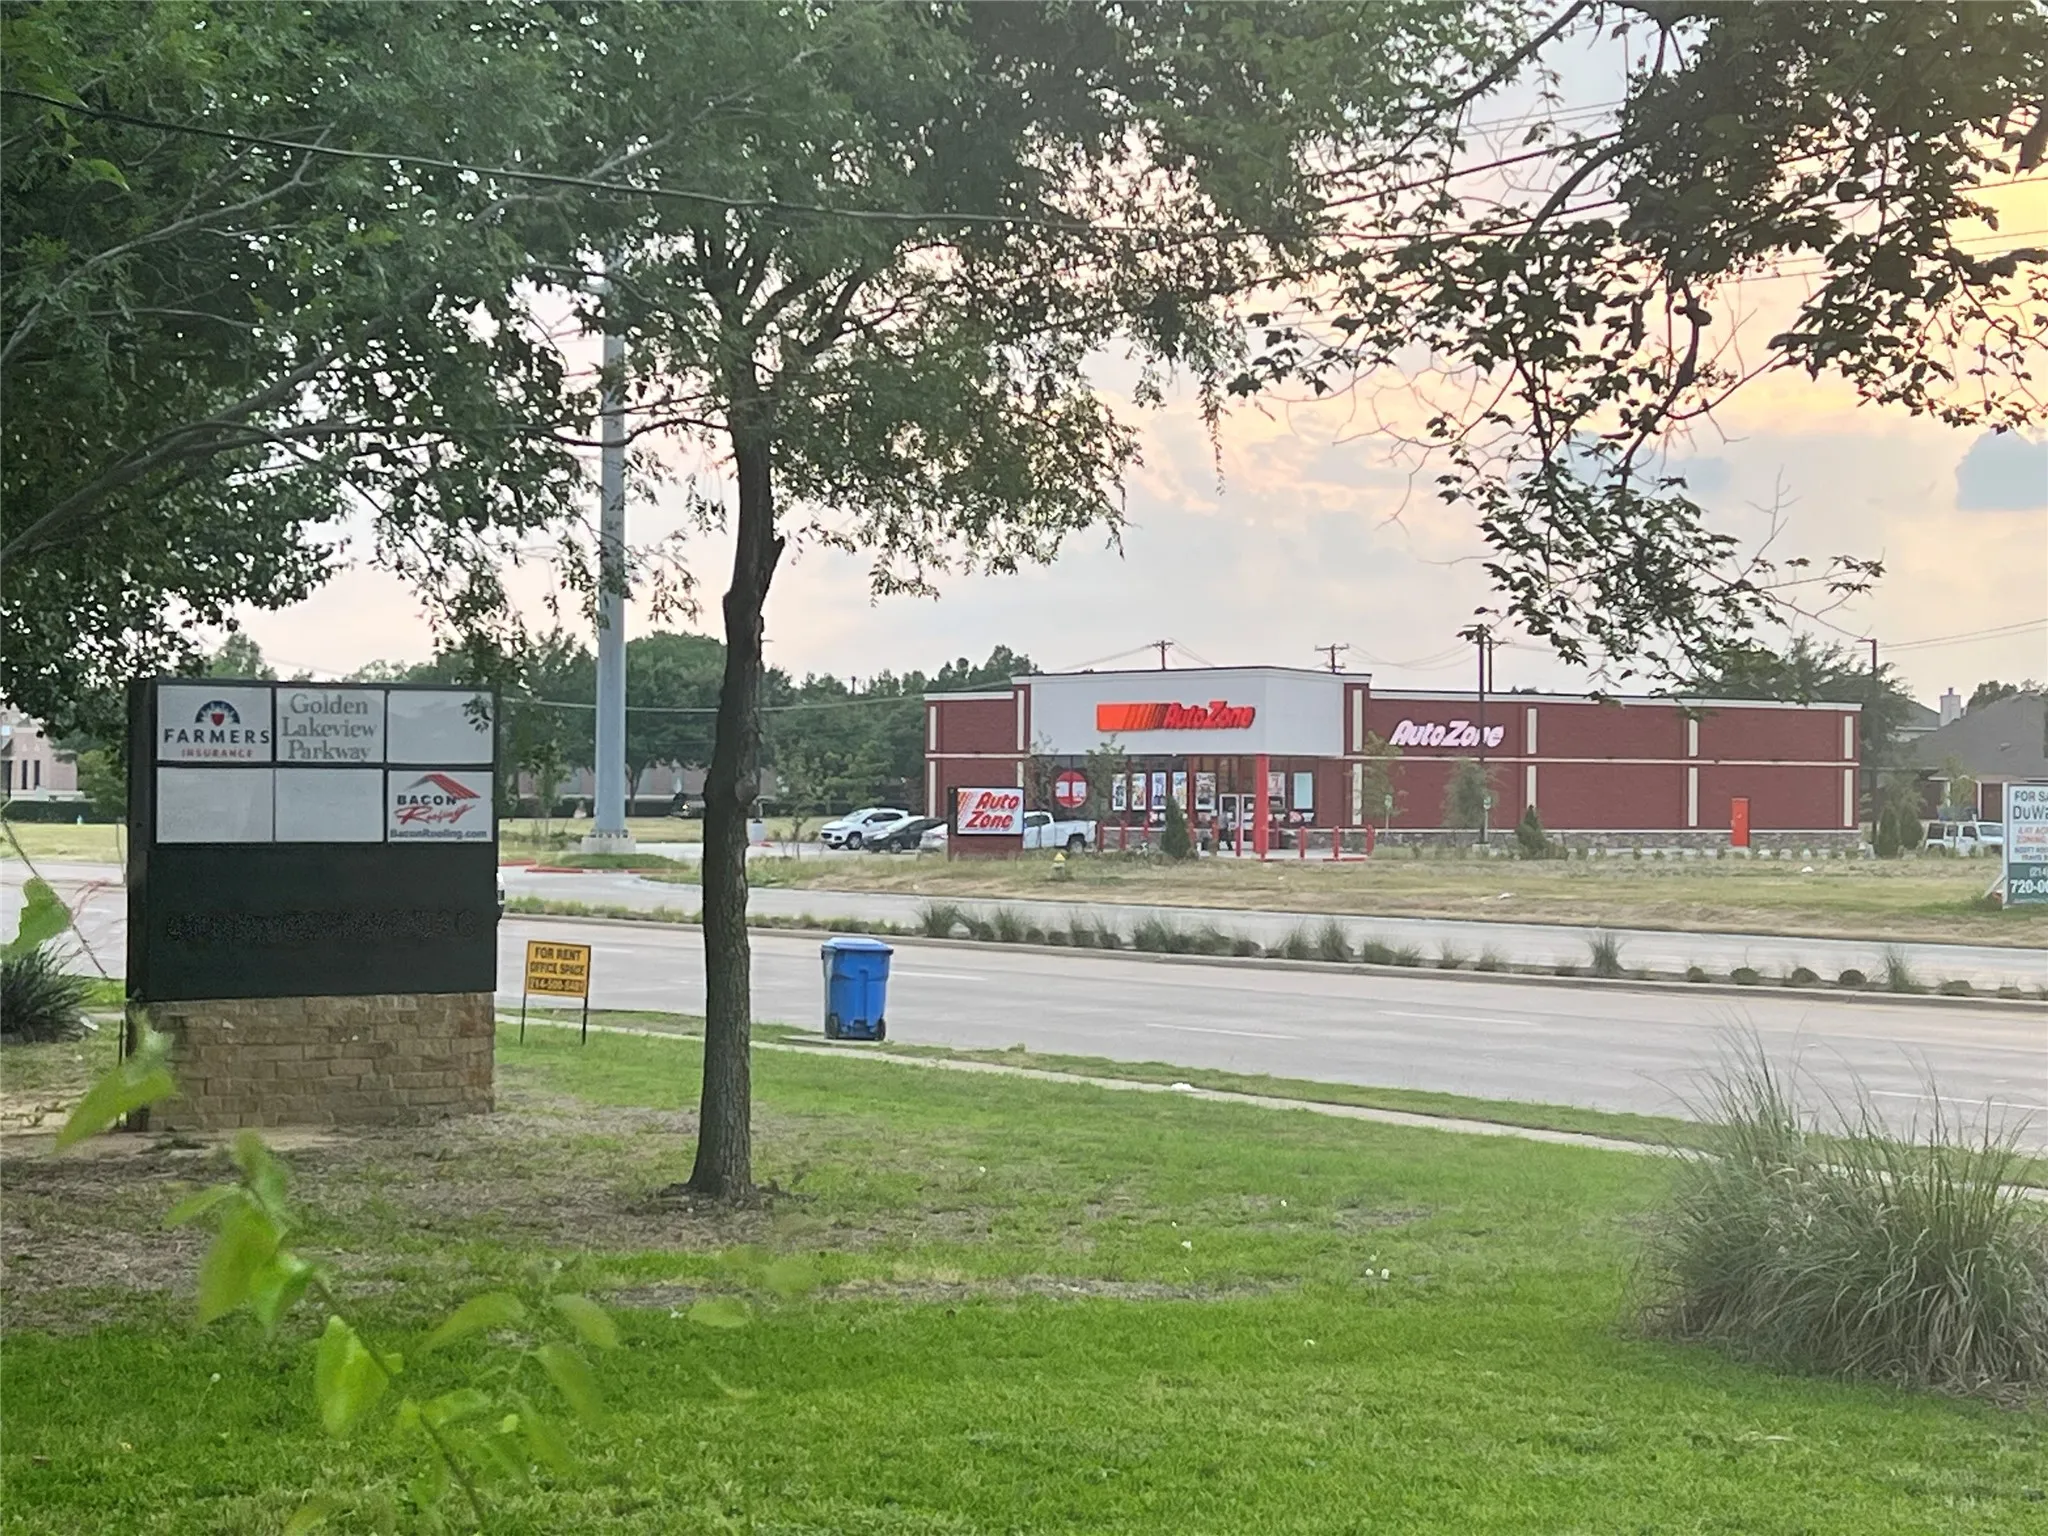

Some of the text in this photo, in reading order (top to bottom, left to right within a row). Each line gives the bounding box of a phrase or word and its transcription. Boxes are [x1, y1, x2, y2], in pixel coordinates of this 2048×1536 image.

[290, 692, 368, 715] Golden
[1163, 700, 1256, 730] AutoZone
[163, 728, 271, 745] FARMERS
[281, 716, 377, 738] Lakeview
[1389, 719, 1504, 748] AutoZone
[181, 748, 253, 759] INSURANCE
[287, 739, 372, 763] Parkway
[397, 794, 457, 806] BACON
[975, 791, 1020, 811] Auto
[2014, 790, 2036, 802] FOR
[965, 810, 1013, 829] Zone
[535, 946, 582, 961] FOR RENT
[530, 961, 585, 976] OFFICE SPACE
